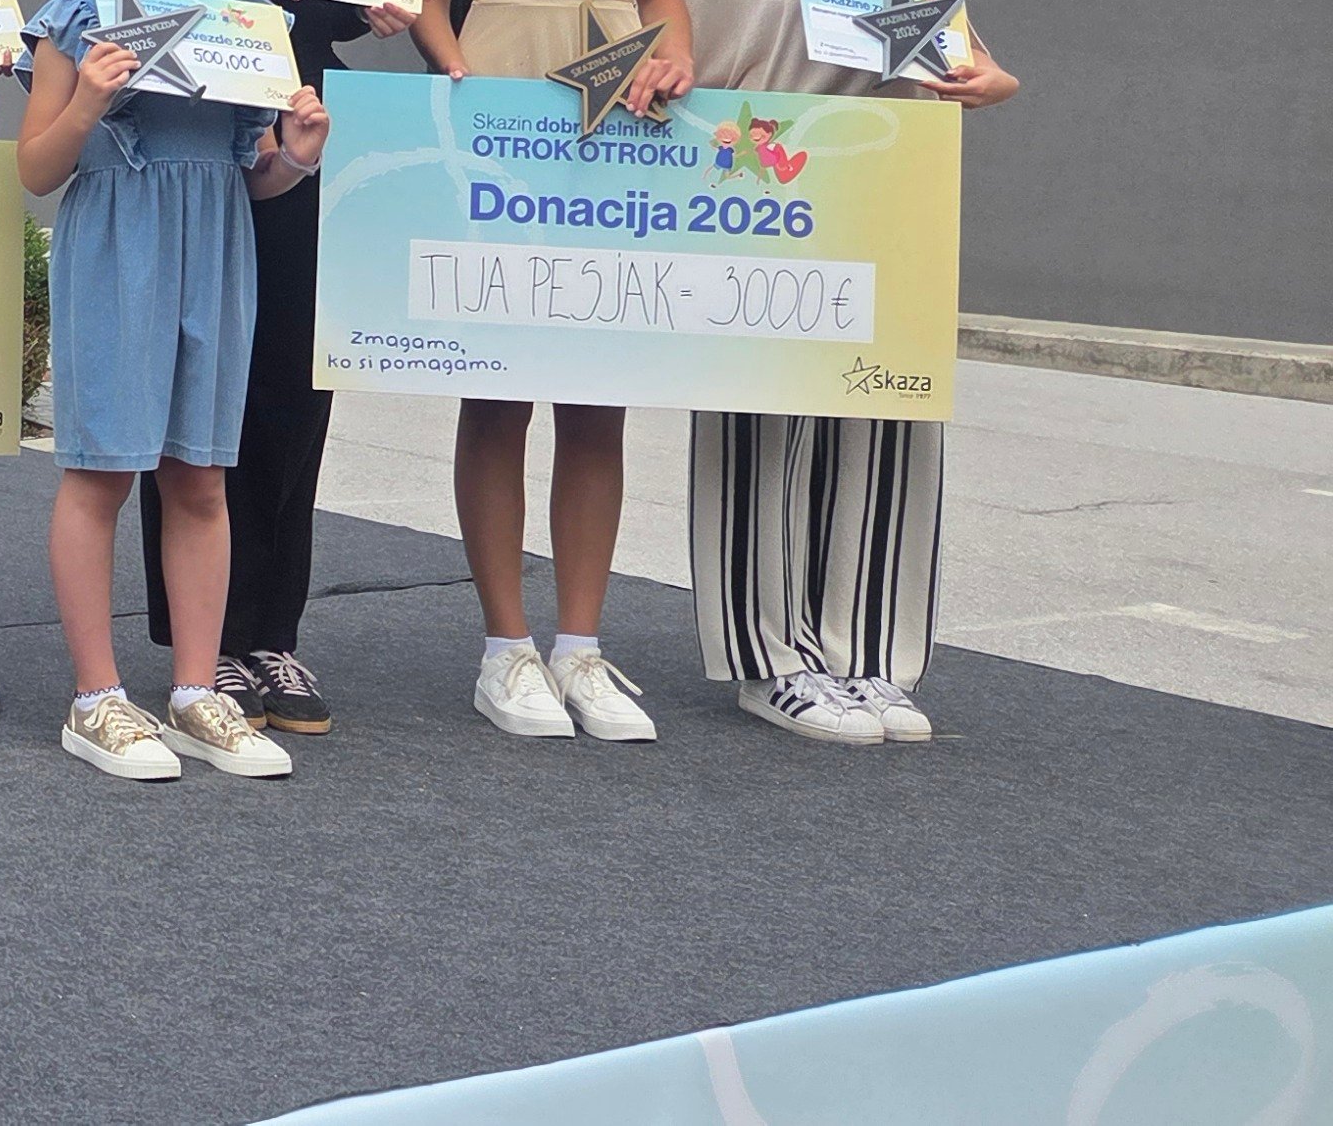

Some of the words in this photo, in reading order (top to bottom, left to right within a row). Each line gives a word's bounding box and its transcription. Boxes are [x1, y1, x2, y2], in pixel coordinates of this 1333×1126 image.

[892, 25, 920, 39] 2026
[124, 38, 156, 52] 2026
[610, 40, 645, 61] ZVEZDA
[590, 66, 623, 88] 2026
[473, 112, 533, 133] Skazin
[536, 116, 639, 138] dobrdelni
[642, 119, 673, 140] tek
[472, 135, 573, 163] OTROK
[577, 142, 698, 168] OTROKU
[469, 182, 677, 238] Donacija
[688, 195, 814, 239] 2026
[351, 331, 466, 355] Zmagamo,
[328, 354, 351, 369] ko
[359, 355, 372, 369] si
[380, 358, 507, 375] pomagamo.
[873, 370, 931, 391] skaza
